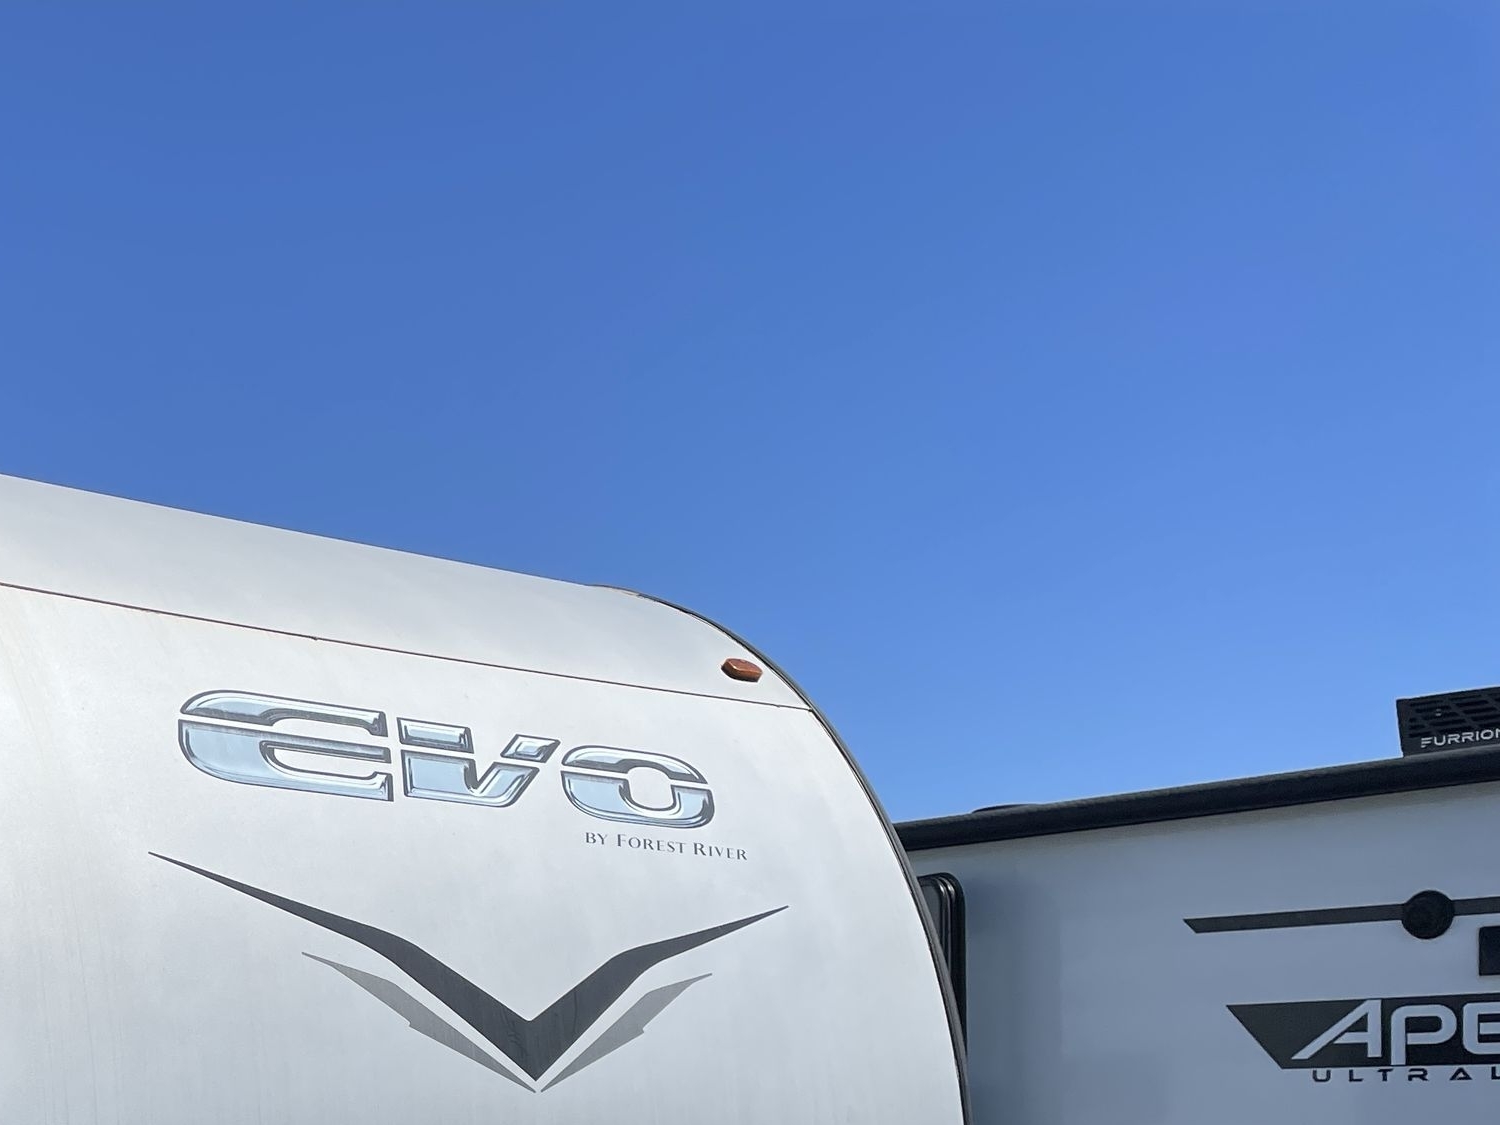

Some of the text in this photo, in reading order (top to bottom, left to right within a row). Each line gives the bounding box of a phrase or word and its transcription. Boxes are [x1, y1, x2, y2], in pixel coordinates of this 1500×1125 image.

[179, 689, 715, 830] EVO
[585, 832, 748, 861] BY FOREST RIVER
